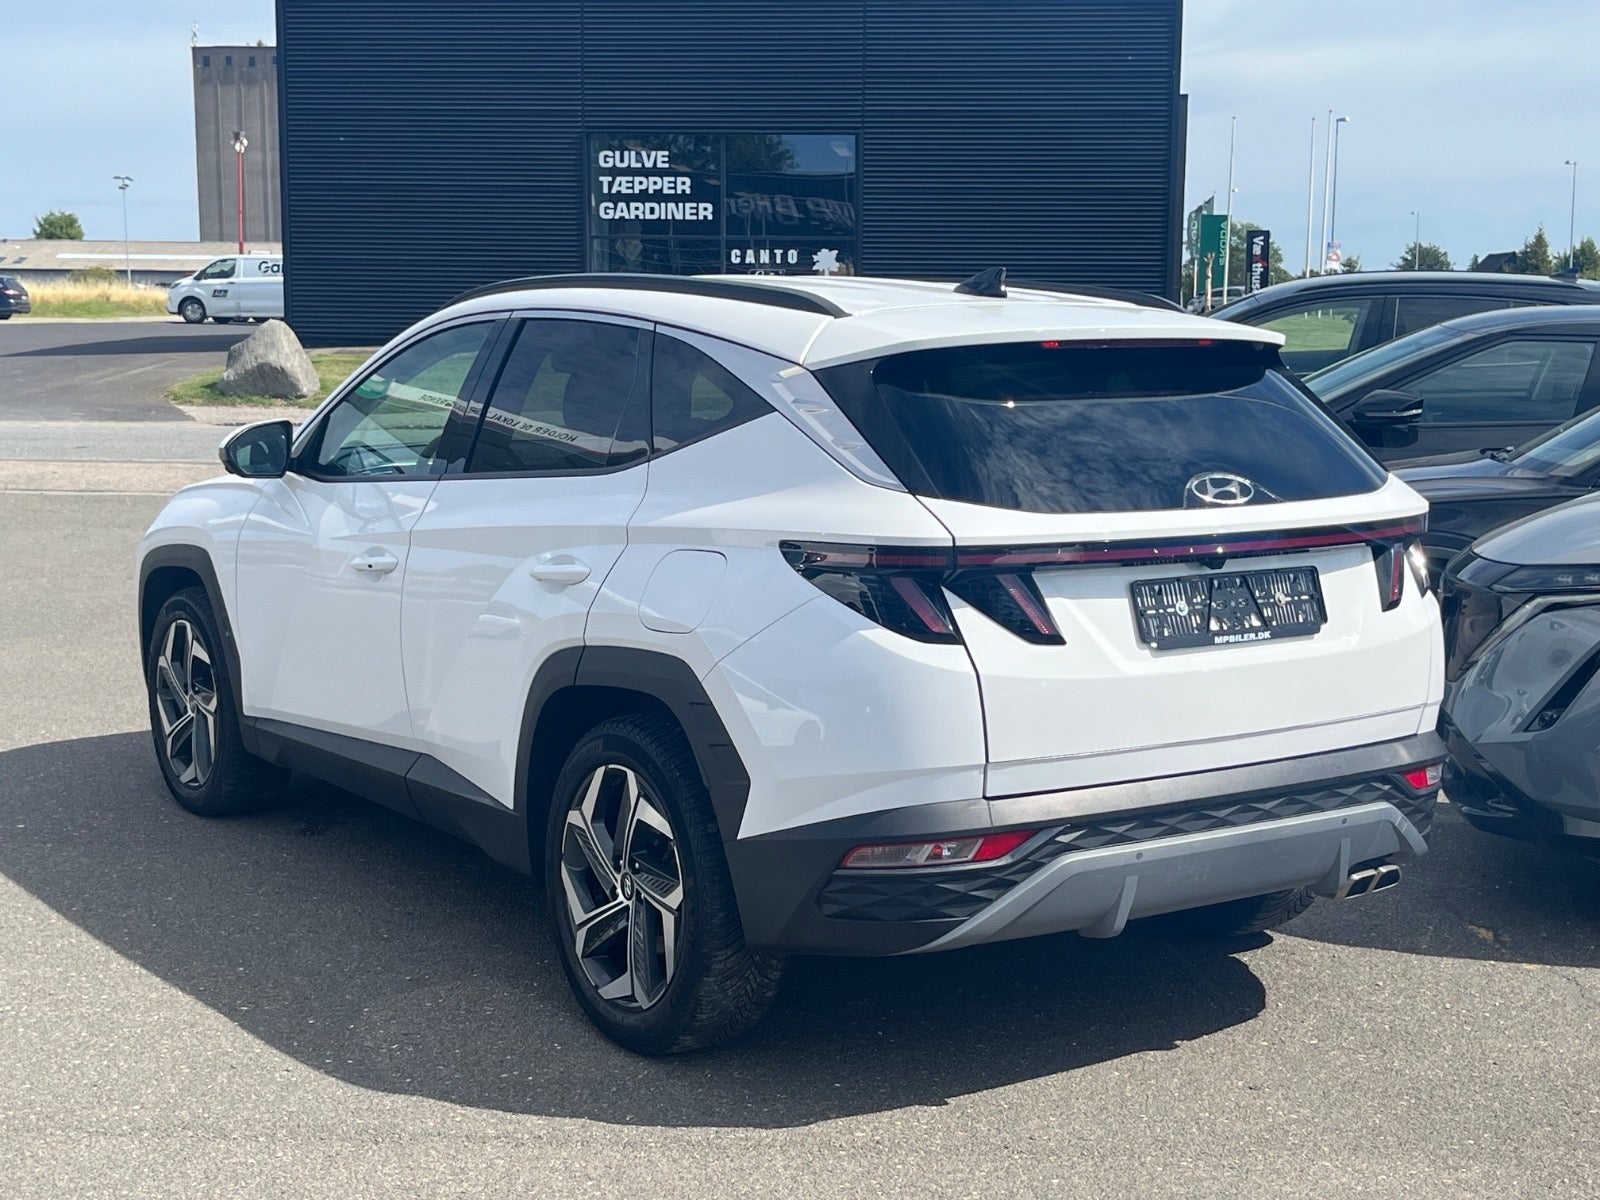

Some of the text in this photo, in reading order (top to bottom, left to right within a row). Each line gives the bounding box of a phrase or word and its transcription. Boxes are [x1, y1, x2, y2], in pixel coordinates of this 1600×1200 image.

[598, 150, 670, 168] GULVE
[598, 176, 692, 195] TÆPPER
[598, 202, 714, 221] GARDINER
[730, 248, 799, 264] CANTO
[257, 260, 284, 274] Ga
[1214, 630, 1271, 645] MPBILER.DK
